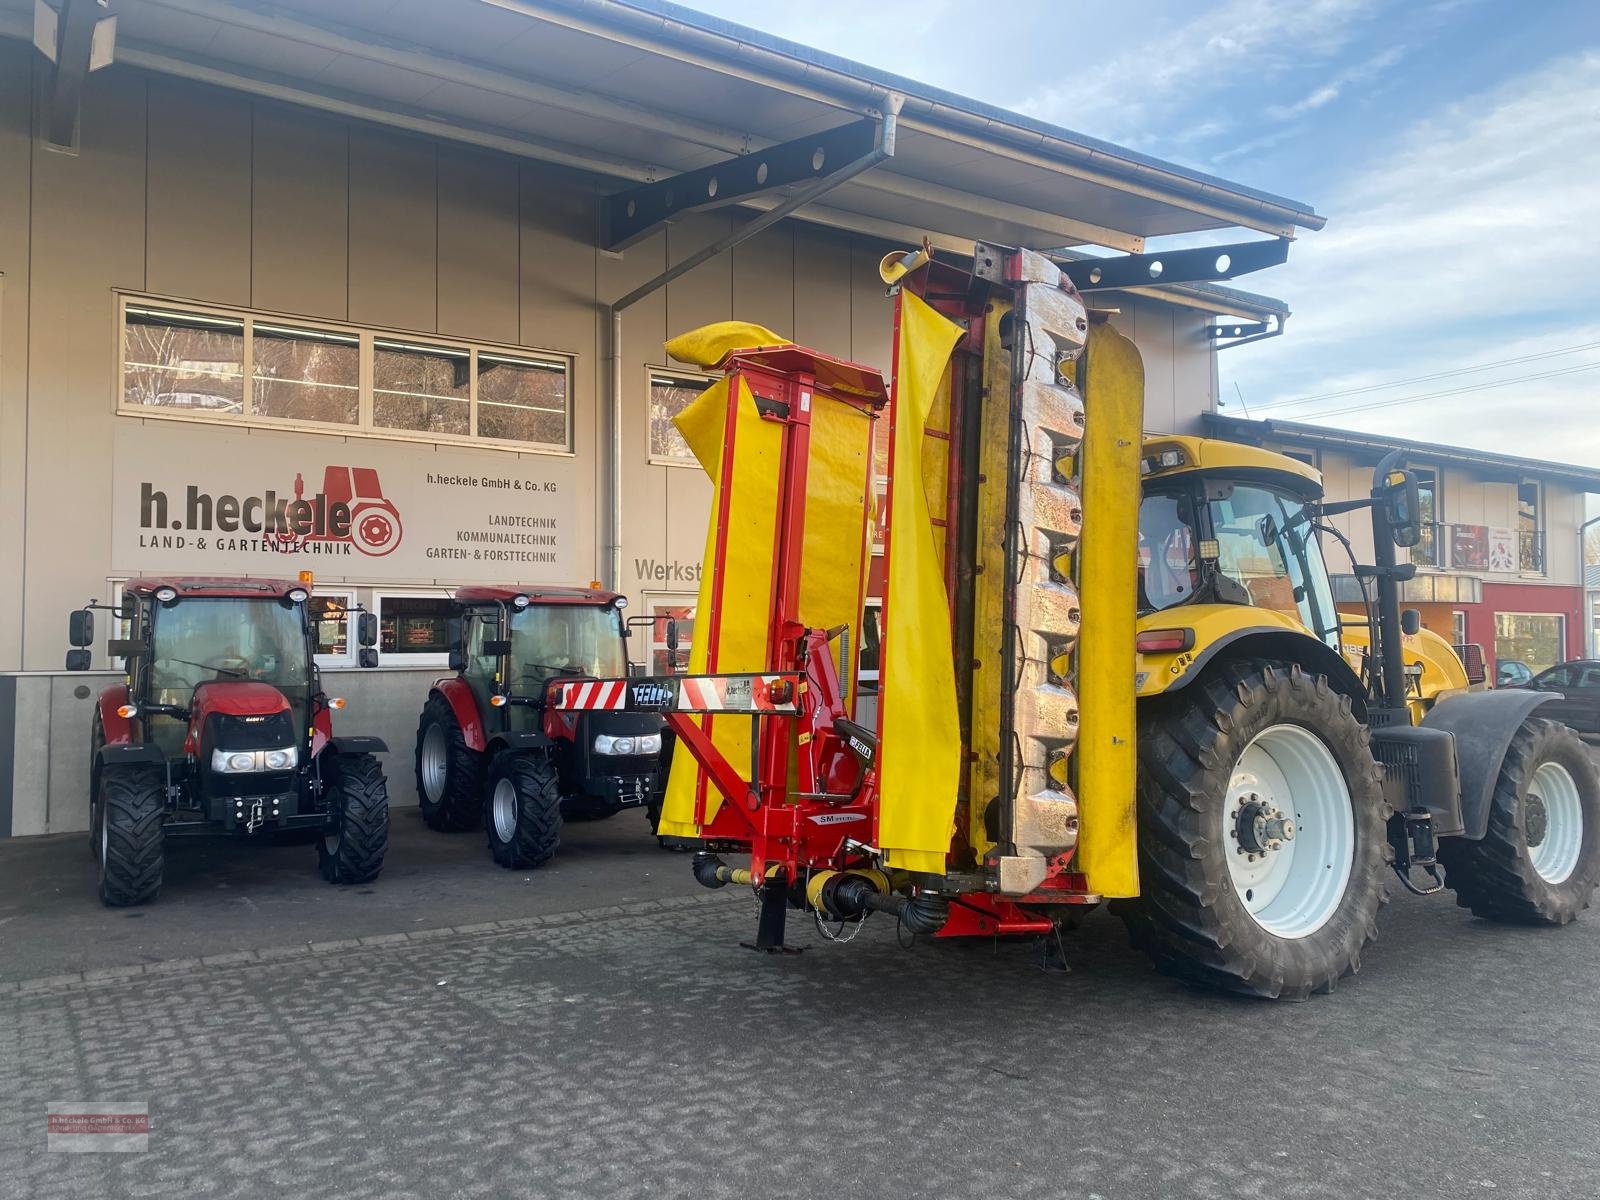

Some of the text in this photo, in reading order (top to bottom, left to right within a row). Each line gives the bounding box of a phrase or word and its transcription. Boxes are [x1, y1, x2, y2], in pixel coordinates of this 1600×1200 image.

[427, 473, 557, 493] h.heckele GmbH & Co. KG
[140, 482, 351, 537] h.heckele
[488, 514, 557, 529] LANDTECHNIK
[456, 530, 557, 546] KOMMUNALTECHNIK
[216, 538, 351, 555] GARTENTECHNIK
[426, 547, 557, 563] GARTEN- & FORSTTECHNIK
[633, 683, 670, 706] FELLA
[820, 815, 834, 823] SM
